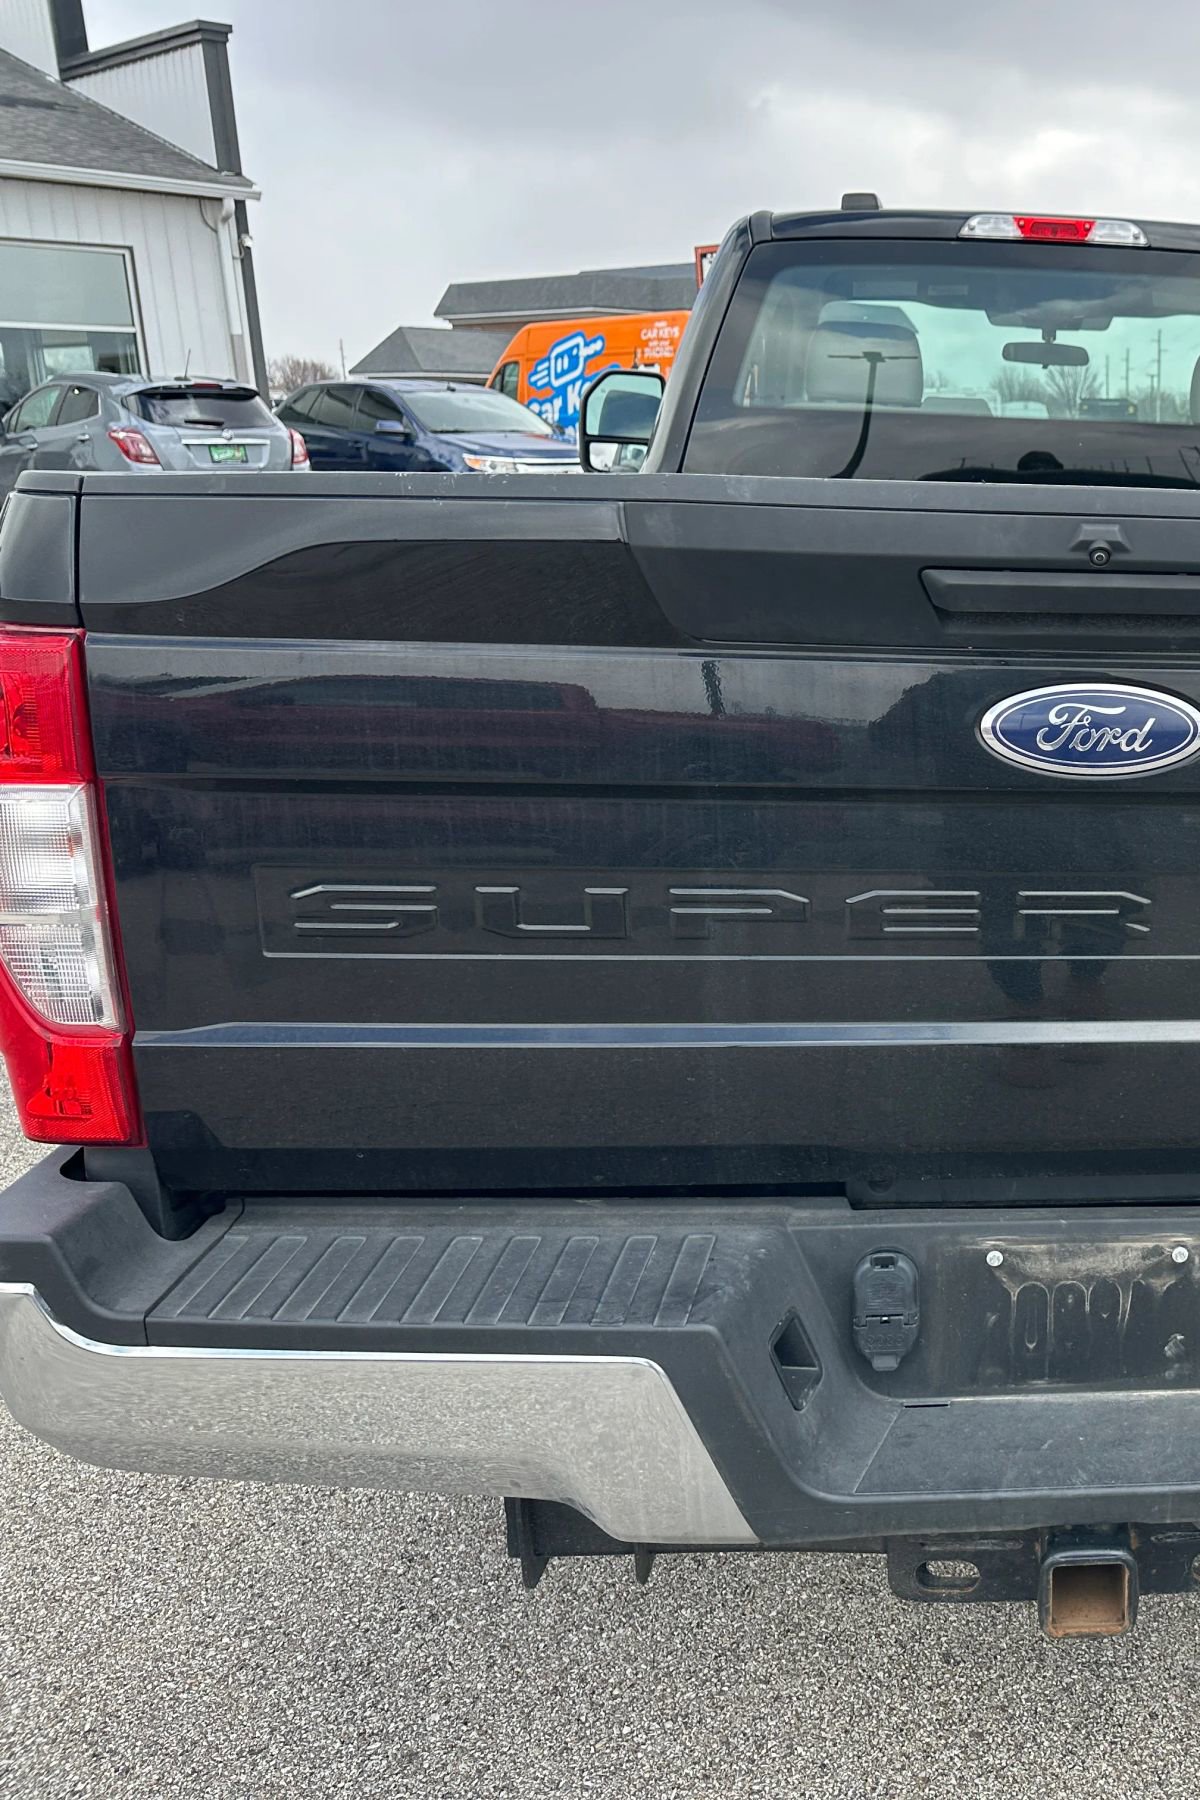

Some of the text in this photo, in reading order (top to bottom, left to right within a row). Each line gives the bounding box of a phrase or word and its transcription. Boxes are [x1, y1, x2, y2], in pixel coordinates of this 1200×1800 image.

[641, 326, 680, 340] CAR KEYS
[1036, 702, 1156, 752] Ford
[290, 884, 1152, 941] SUPER
